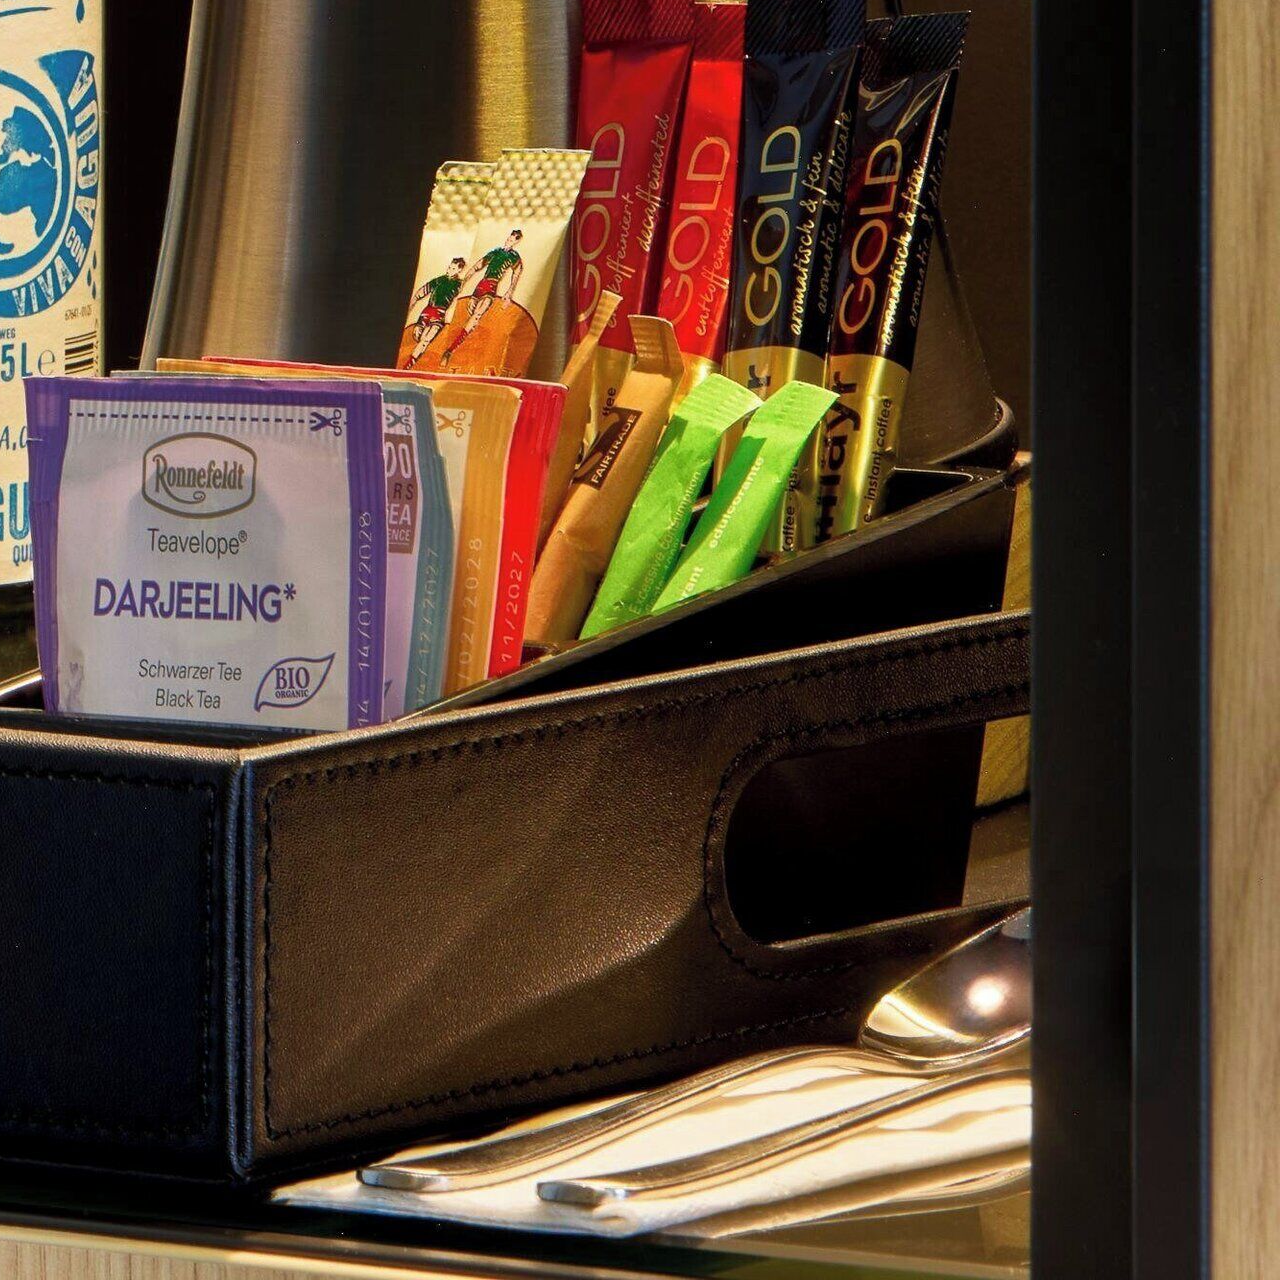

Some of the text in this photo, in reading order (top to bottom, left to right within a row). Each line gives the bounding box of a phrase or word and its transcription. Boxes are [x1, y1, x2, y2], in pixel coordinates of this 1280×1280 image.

[577, 122, 625, 323] GOLD
[635, 112, 671, 254] decaffeinated
[664, 136, 731, 326] GOLD
[745, 124, 801, 328] GOLD
[12, 255, 75, 317] VIVA
[694, 207, 734, 337] entkoffeiniert
[791, 152, 827, 336] aromatisch & fein
[817, 221, 838, 315] aromatic
[840, 138, 903, 336] GOLD
[881, 231, 913, 346] aromatisch
[901, 163, 925, 211] fein
[152, 453, 246, 505] Ronnefeldt
[591, 414, 638, 485] FAIRTRADE
[869, 397, 893, 501] instant coffee
[629, 551, 665, 616] Excessive
[138, 658, 243, 682] Schwarzer Tee
[155, 687, 222, 710] Black Tea
[274, 666, 311, 691] BIO
[274, 689, 310, 700] ORGANIC
